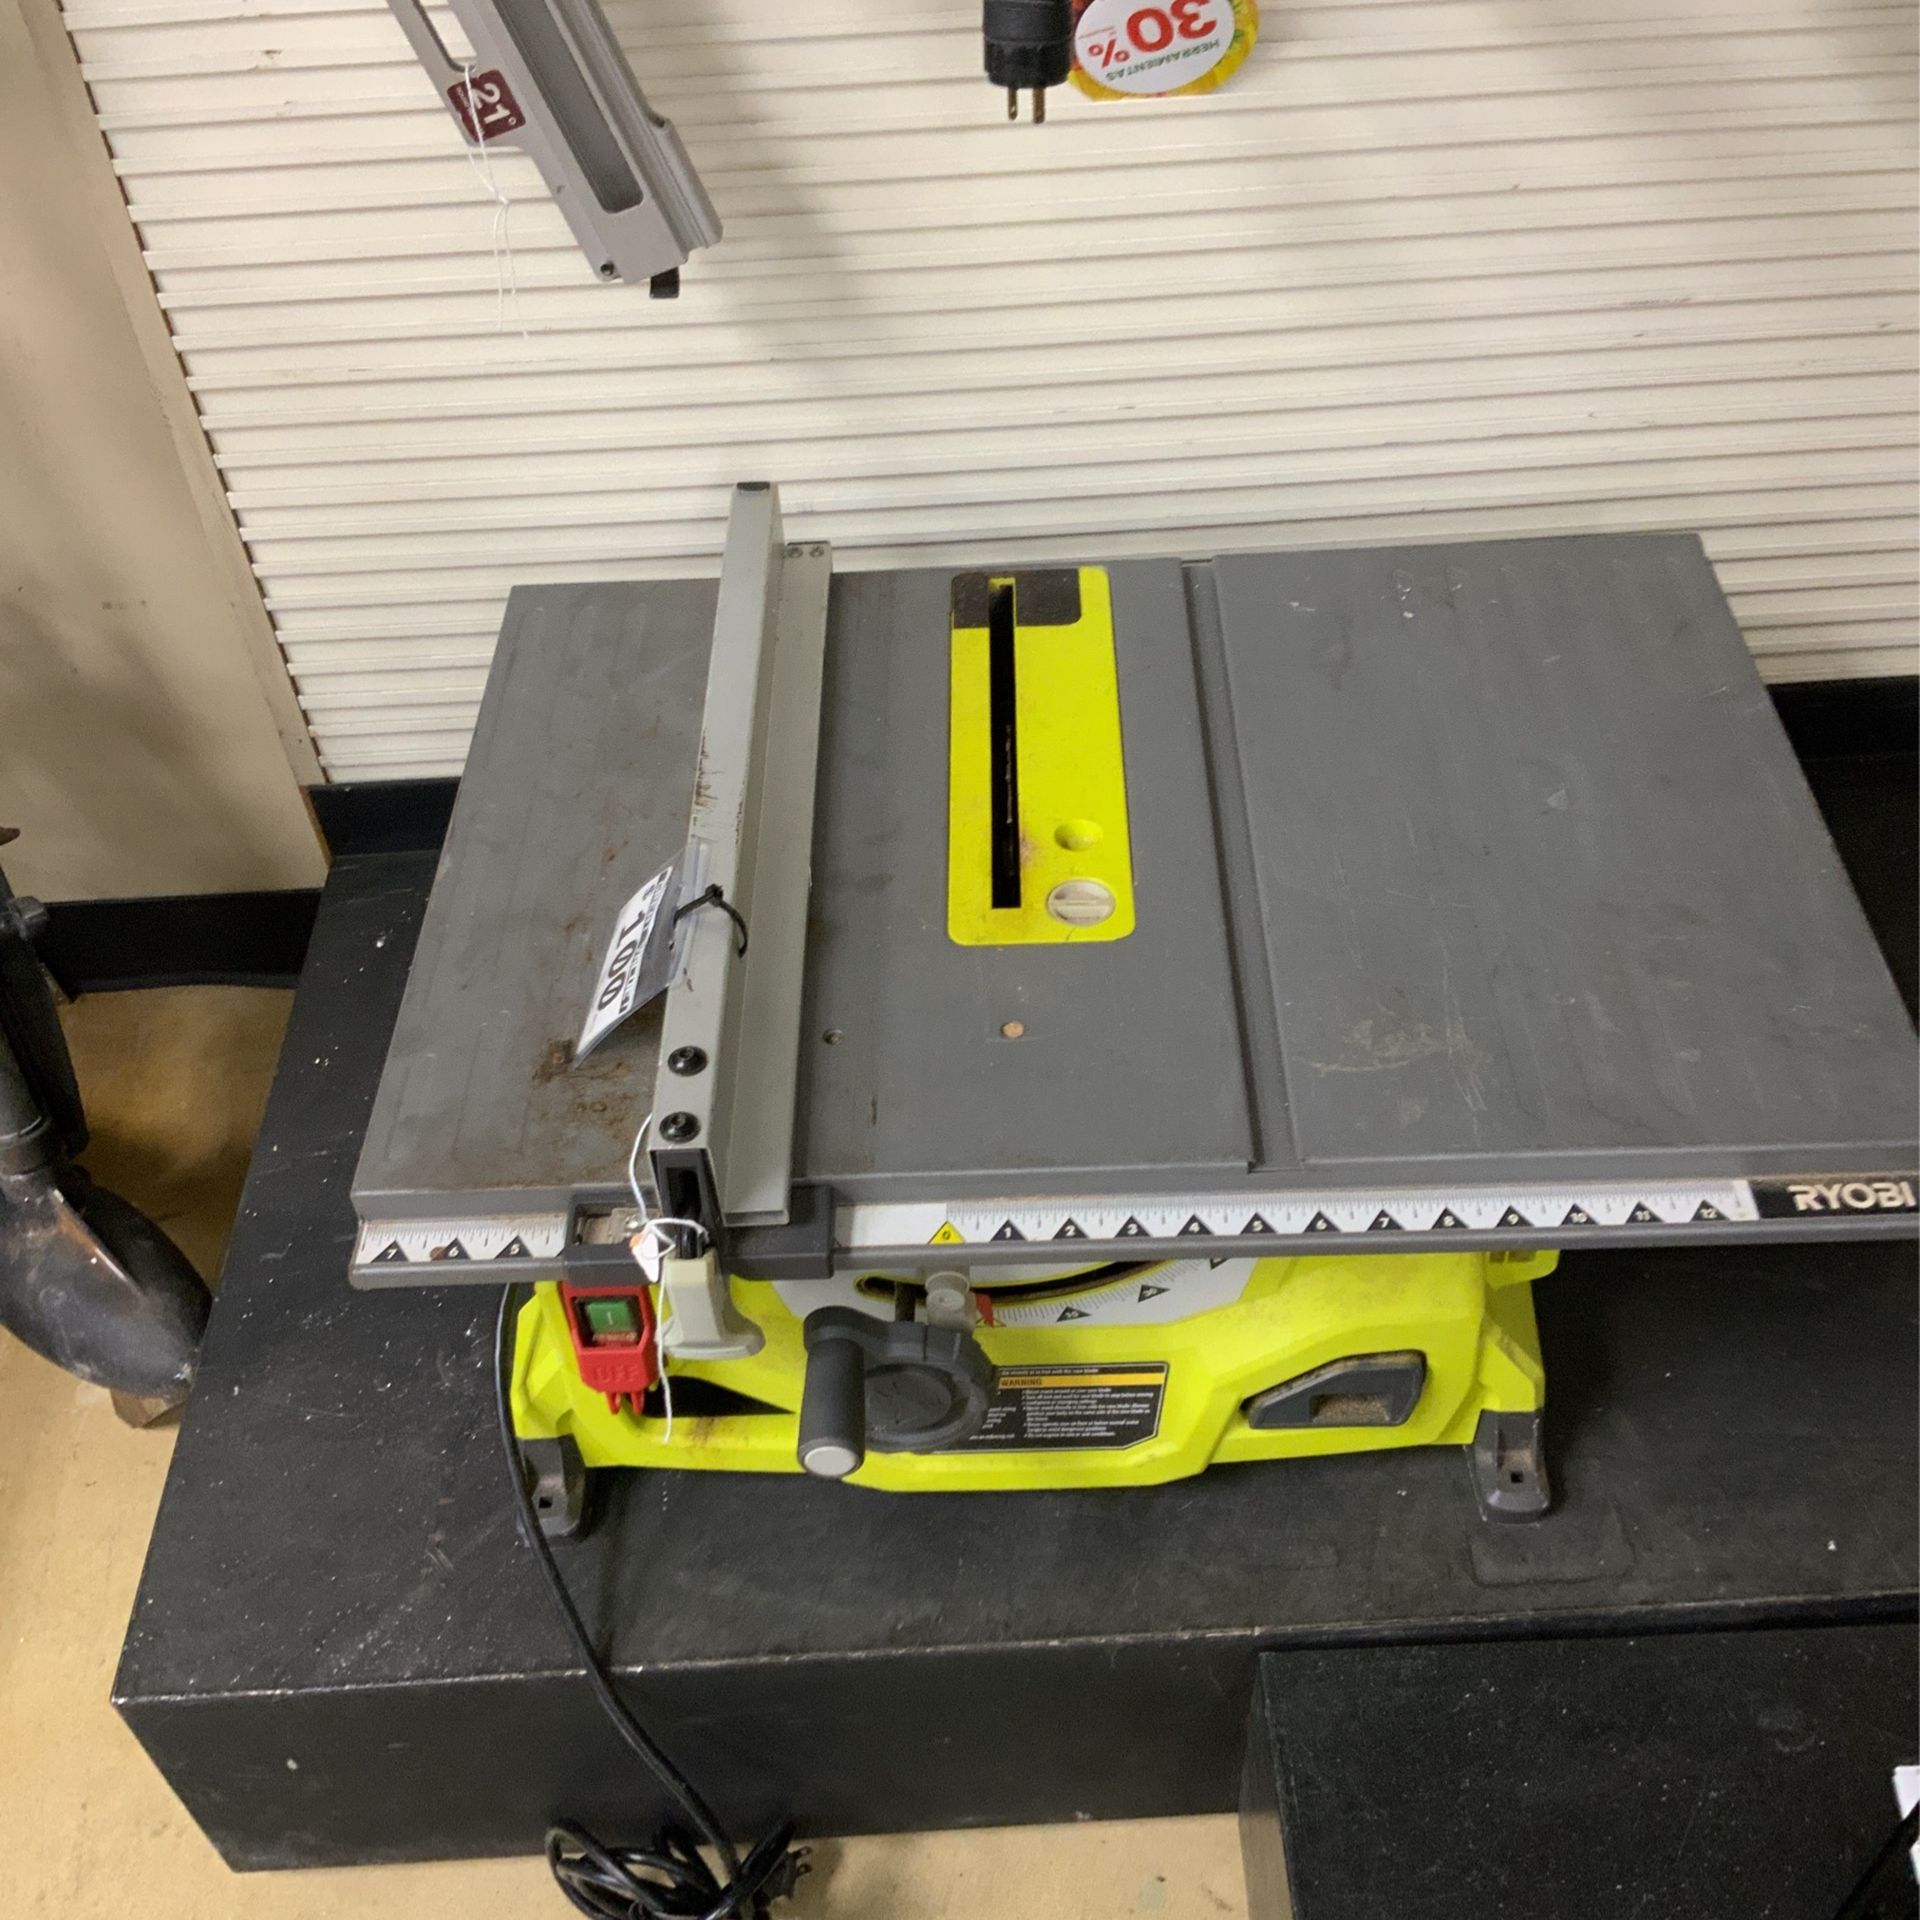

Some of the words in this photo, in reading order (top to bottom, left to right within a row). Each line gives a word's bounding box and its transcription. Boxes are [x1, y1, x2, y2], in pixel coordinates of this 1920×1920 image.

[1088, 0, 1217, 68] 30%
[1105, 38, 1218, 81] HERRAMIENTAS
[1787, 1182, 1917, 1211] RYOBI
[1004, 1227, 1012, 1238] 1
[1065, 1225, 1076, 1237] 2
[1127, 1223, 1138, 1235] 3
[1188, 1222, 1200, 1233] 4
[1252, 1220, 1264, 1232] 5
[1316, 1219, 1327, 1230] 6
[1379, 1217, 1390, 1228] 7
[1443, 1215, 1455, 1227] 8
[1507, 1213, 1519, 1225] 9
[386, 1249, 397, 1259] 7
[448, 1247, 459, 1257] 6
[510, 1244, 521, 1255] 5
[1001, 1378, 1042, 1387] WARNING
